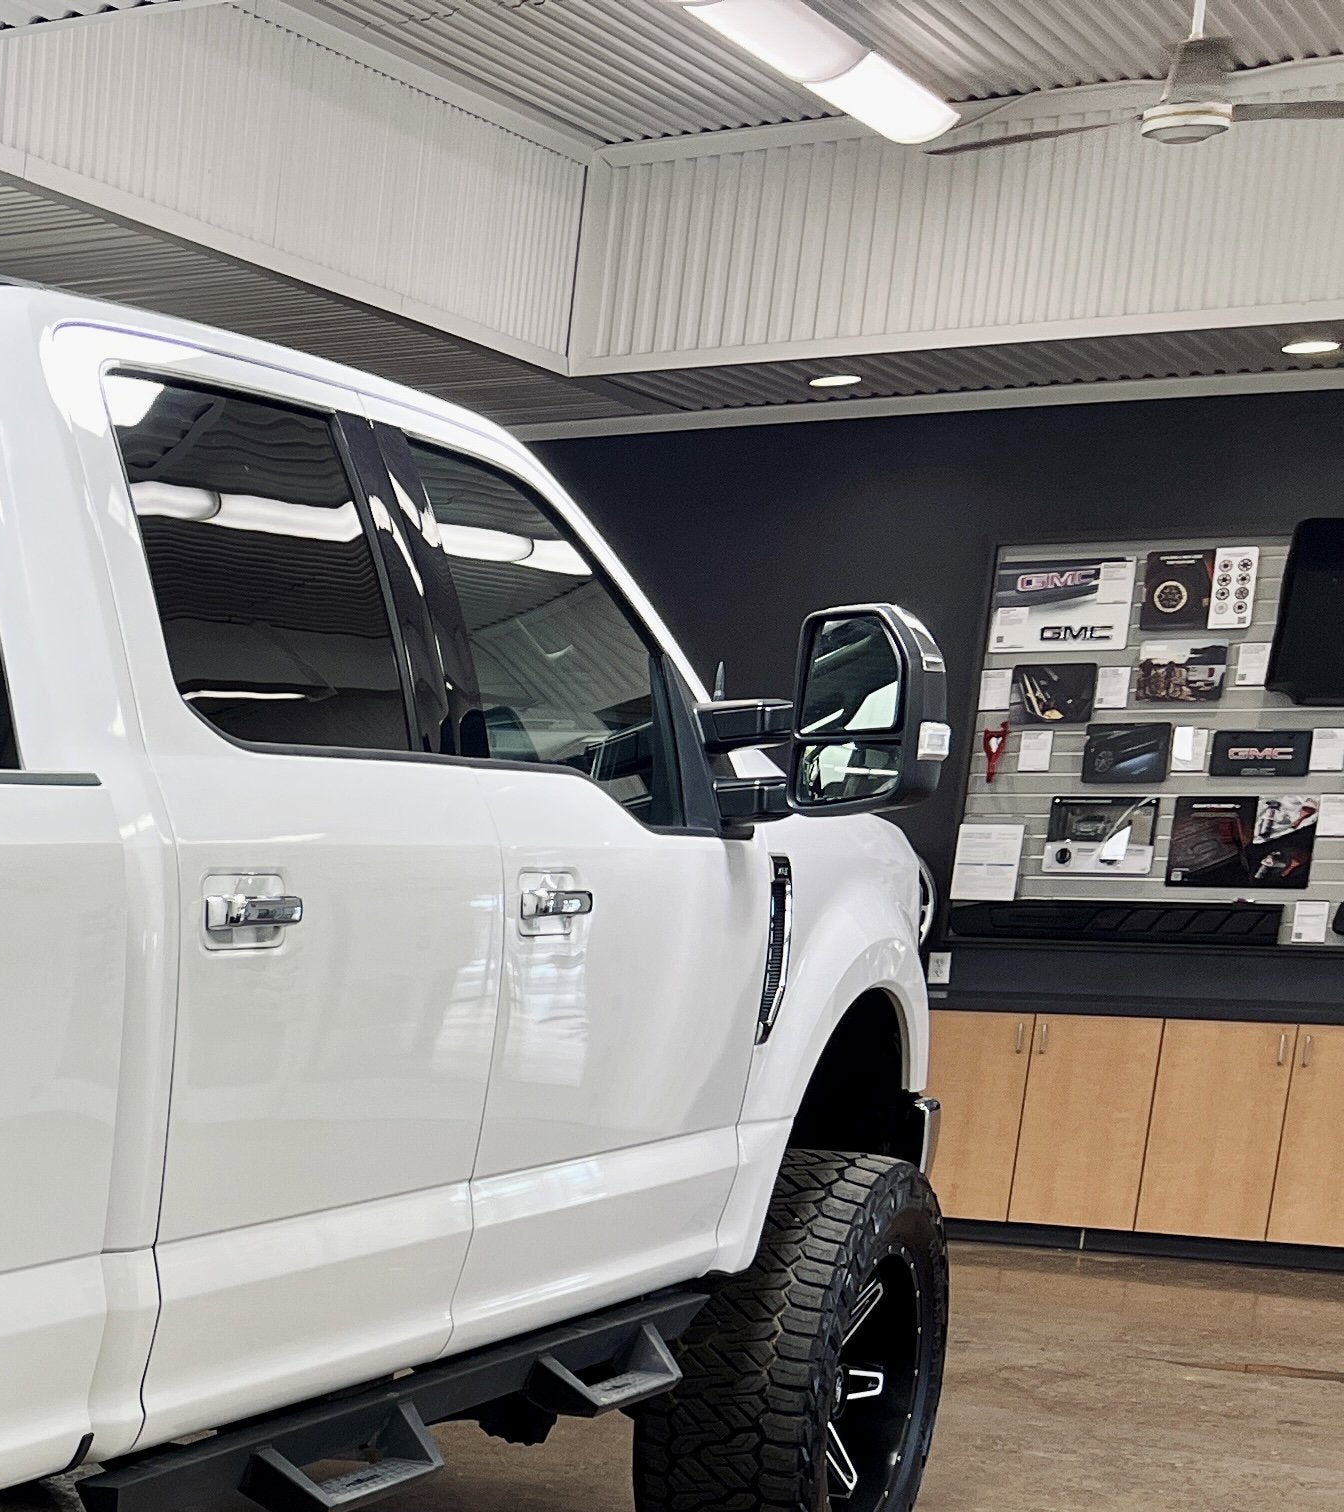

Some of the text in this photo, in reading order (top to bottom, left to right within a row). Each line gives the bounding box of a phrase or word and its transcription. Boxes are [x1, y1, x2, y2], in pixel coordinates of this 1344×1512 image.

[1017, 569, 1096, 592] GMC
[1040, 625, 1113, 642] GMC
[1228, 747, 1294, 760] GMC
